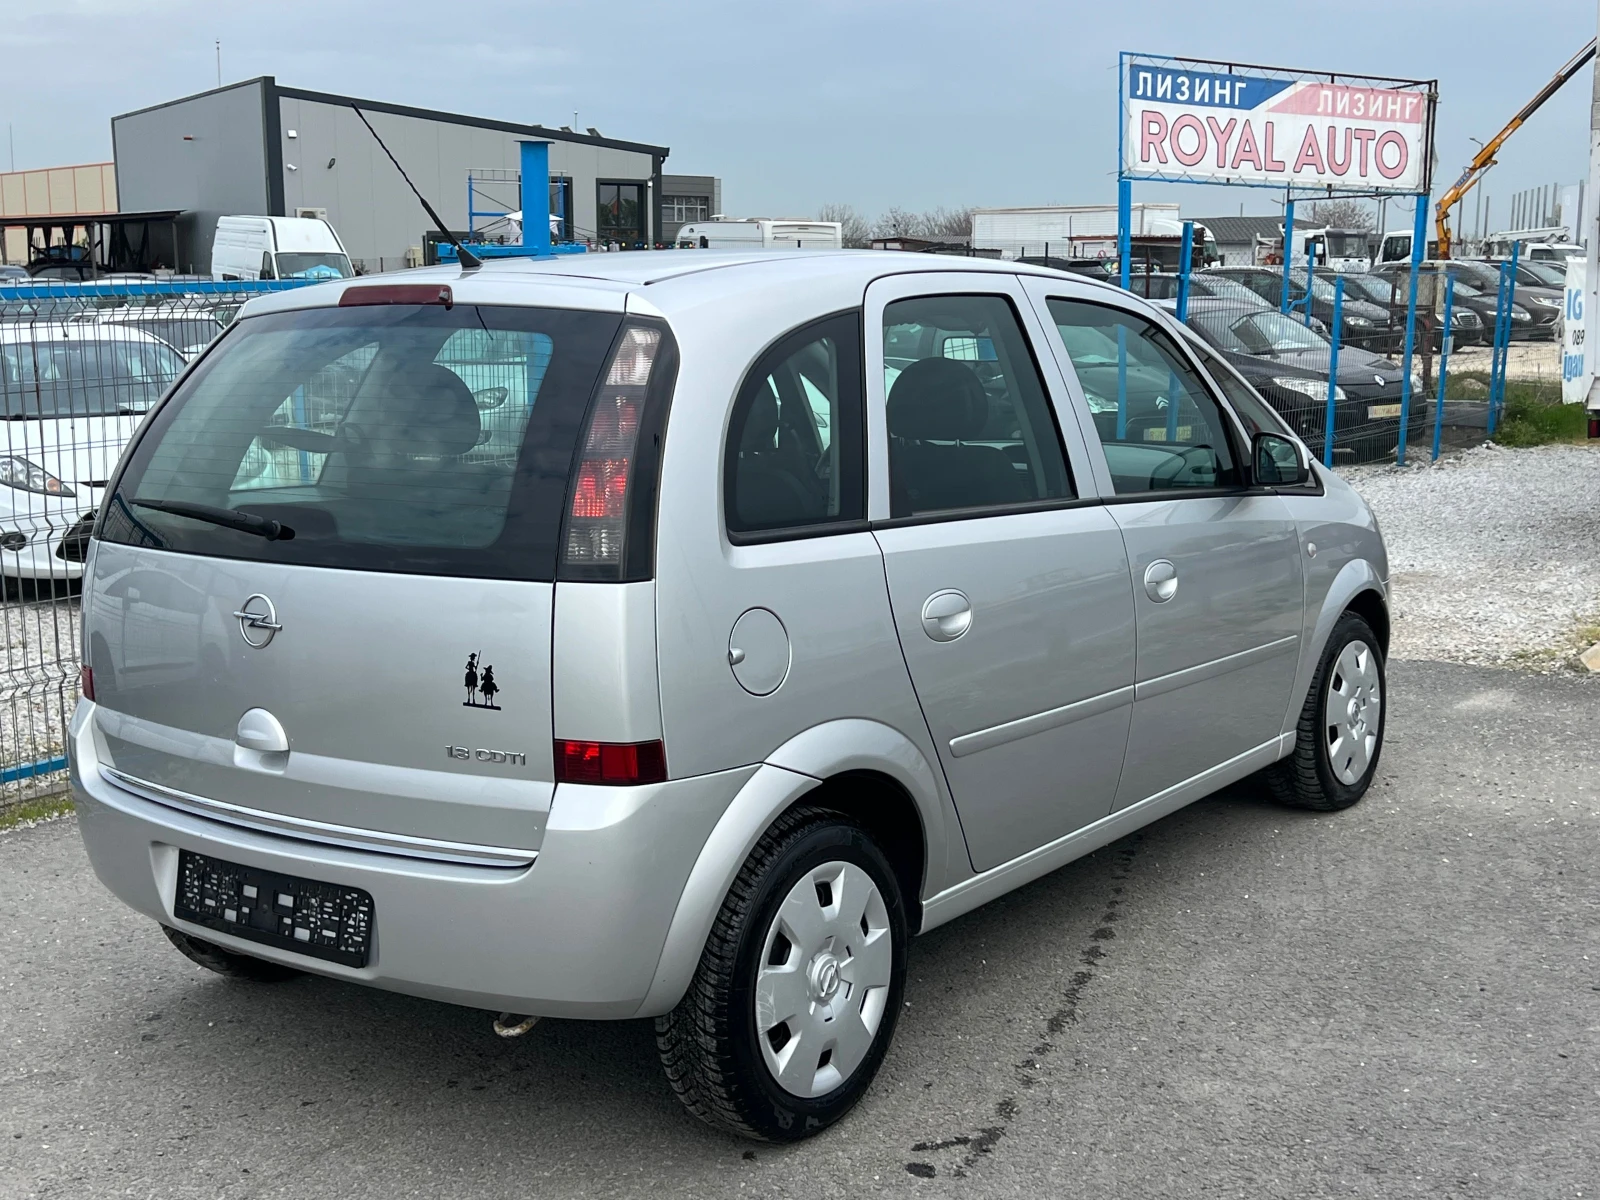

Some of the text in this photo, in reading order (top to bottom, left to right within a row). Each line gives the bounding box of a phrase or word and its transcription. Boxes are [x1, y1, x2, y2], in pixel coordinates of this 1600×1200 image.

[1136, 72, 1247, 105] ЛИЗИНГ
[1316, 90, 1418, 120] ЛИЗИНГ
[1140, 110, 1408, 179] ROYAL AUTO
[1566, 288, 1583, 321] IG
